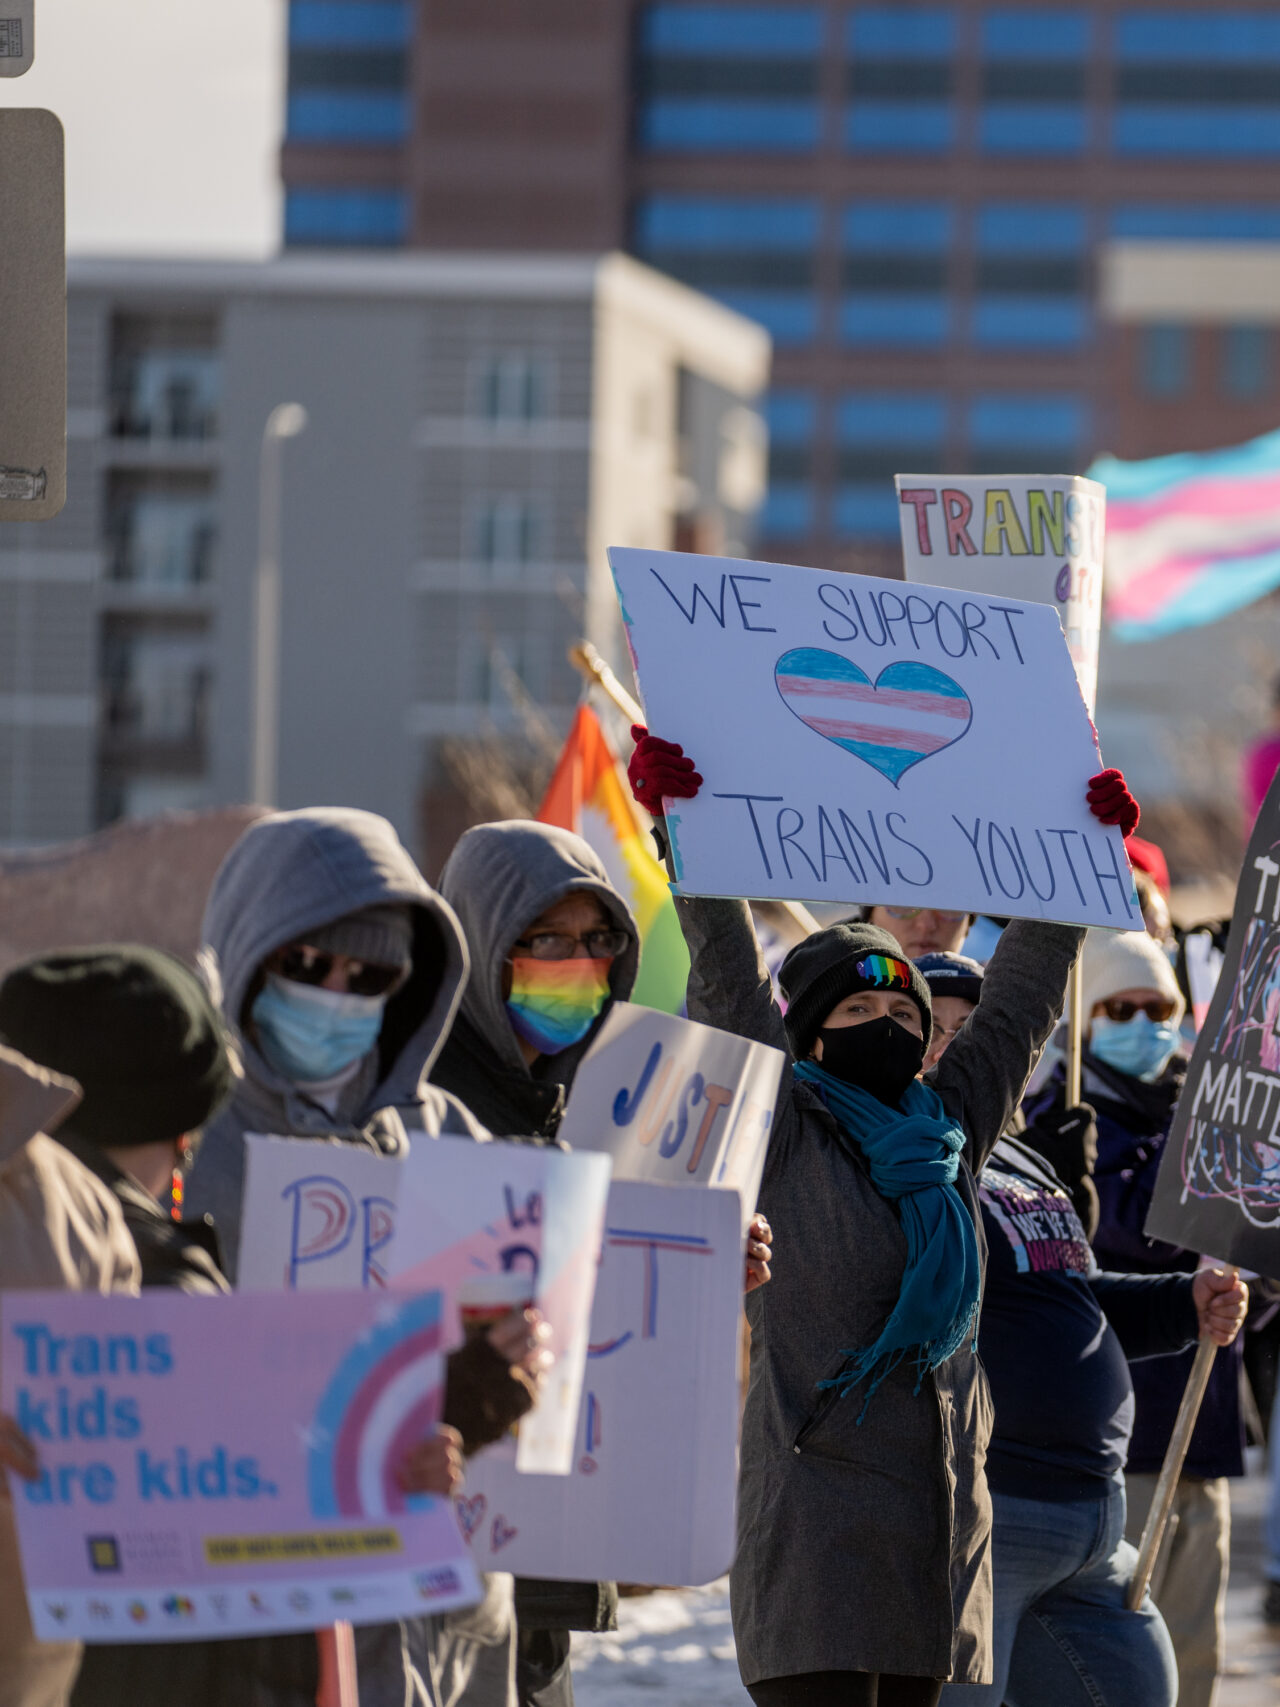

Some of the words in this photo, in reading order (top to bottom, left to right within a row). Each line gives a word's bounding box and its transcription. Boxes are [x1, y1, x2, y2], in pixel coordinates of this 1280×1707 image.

[650, 568, 776, 633] WE
[817, 583, 1024, 665] SUPPORT
[712, 793, 933, 887] TRANS
[952, 814, 1133, 920] YOUTH
[12, 1321, 174, 1377] Trans
[16, 1386, 142, 1440] kids
[136, 1446, 278, 1501] kids.
